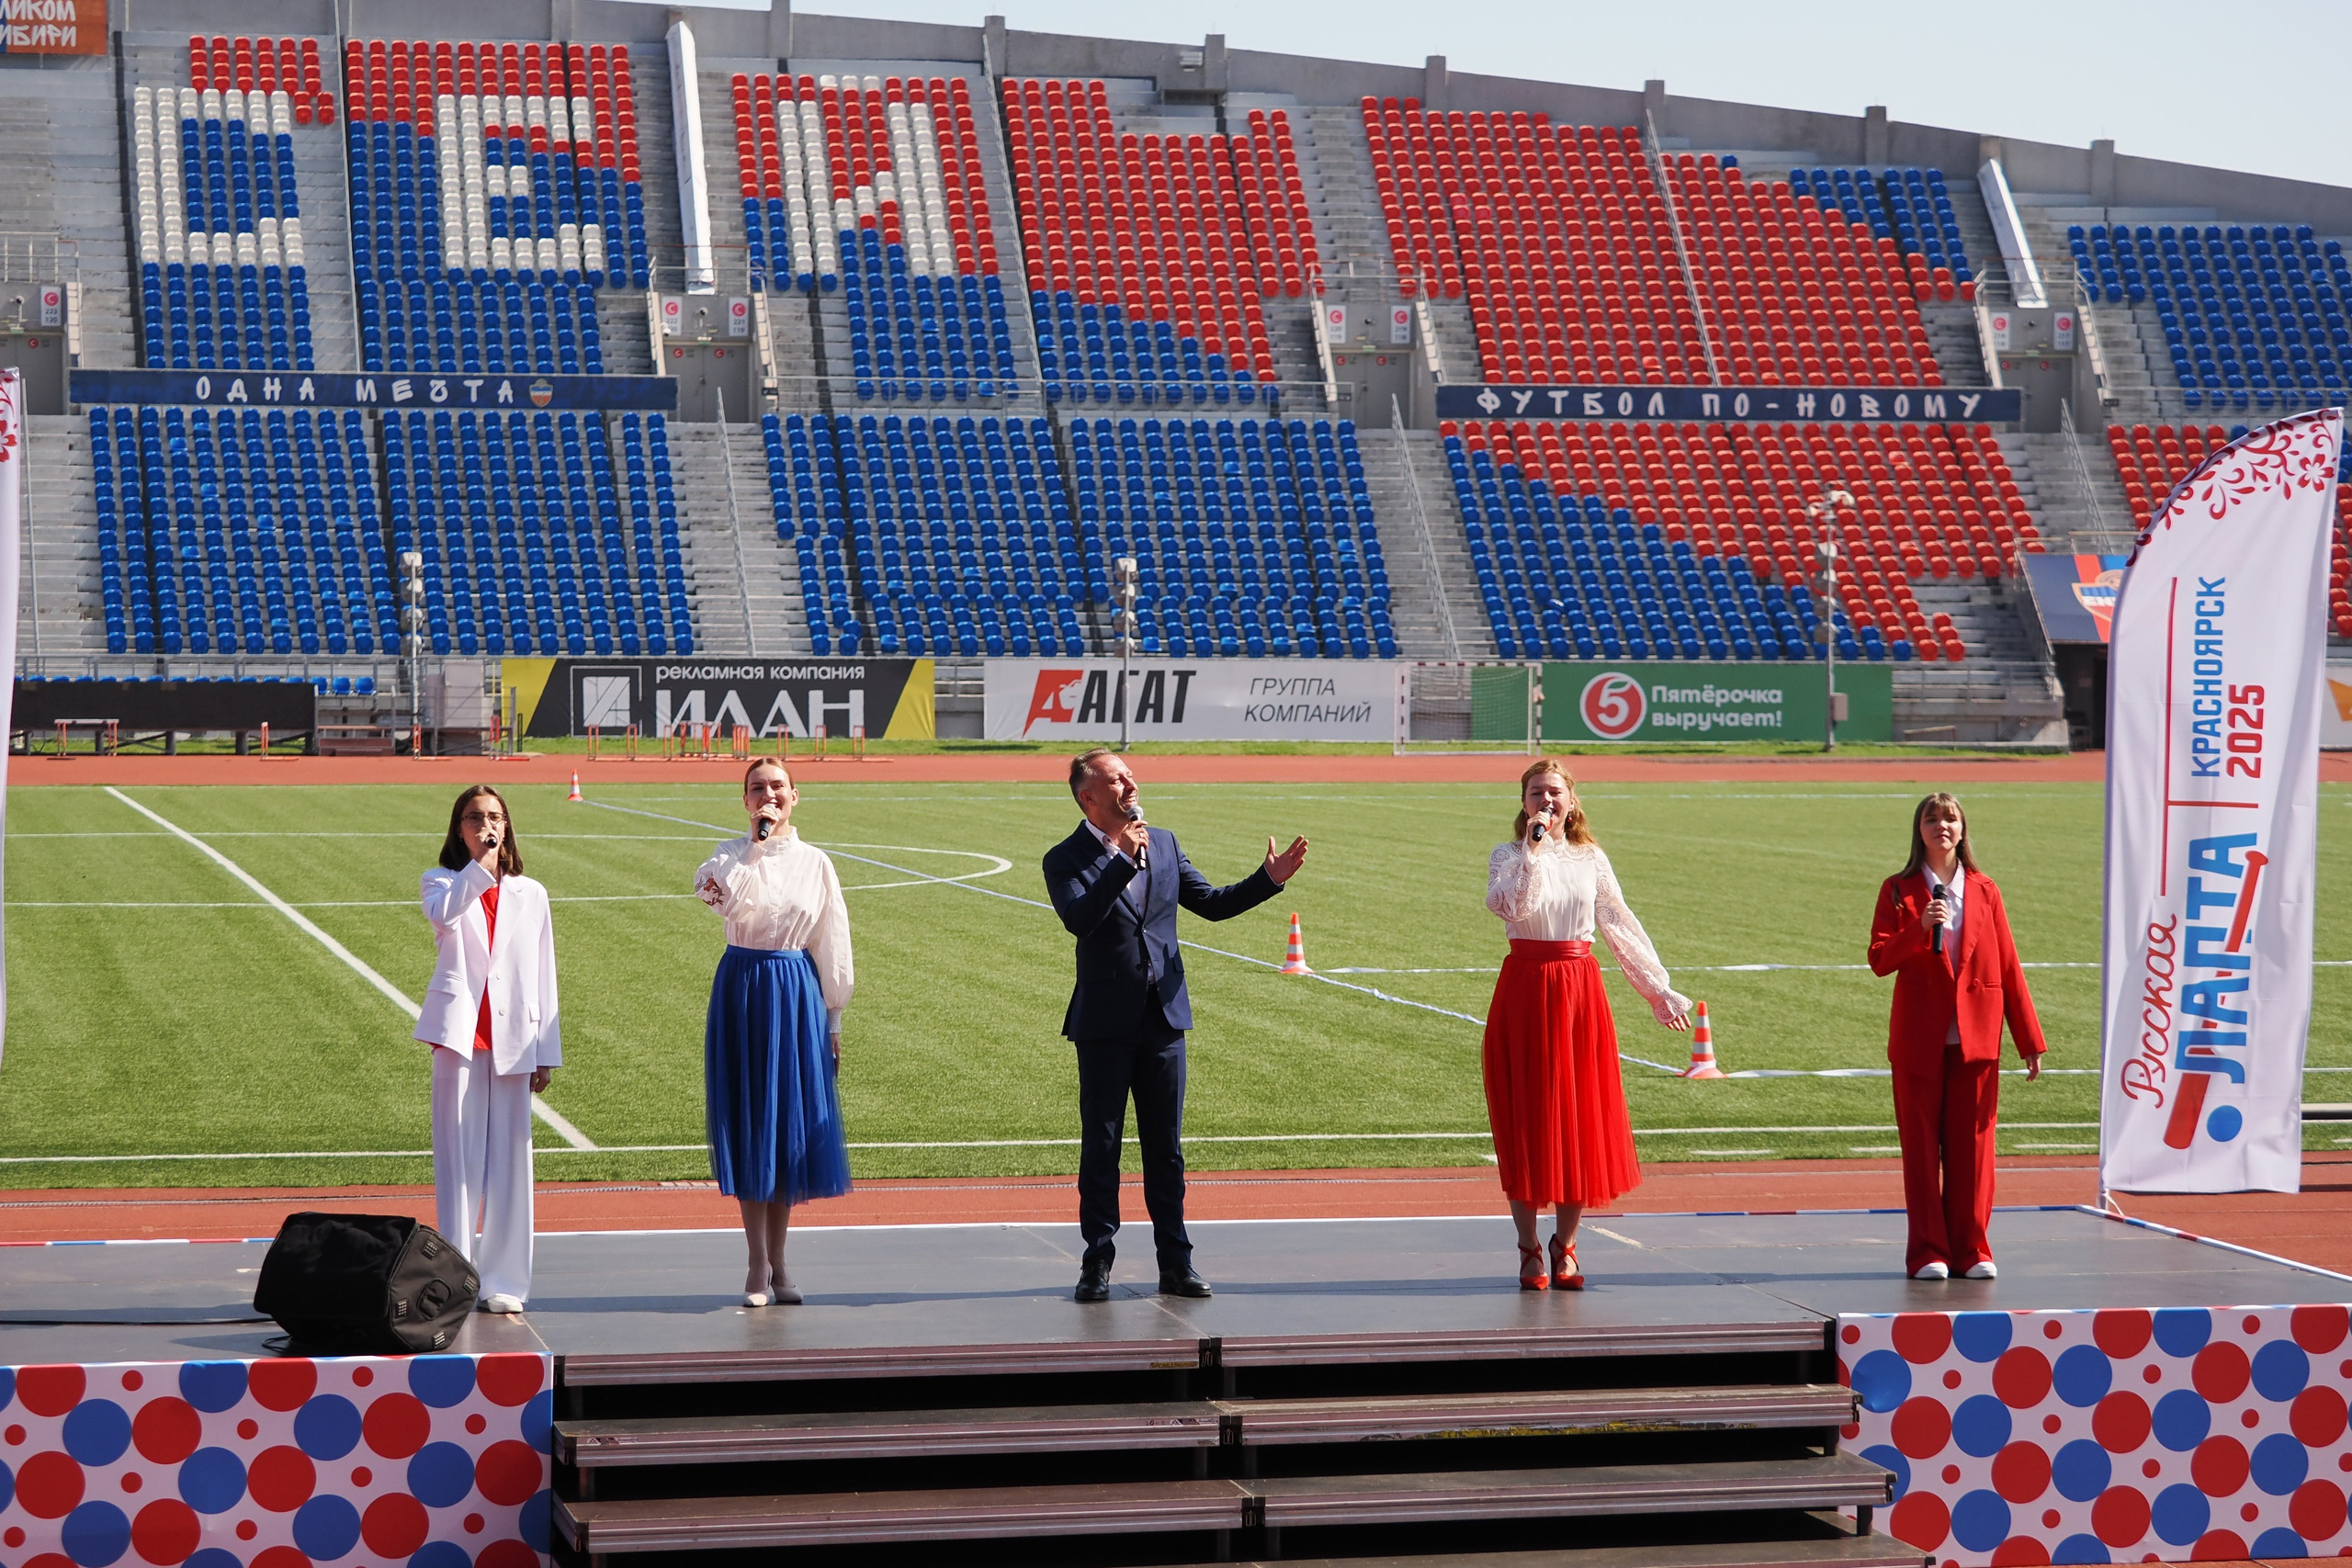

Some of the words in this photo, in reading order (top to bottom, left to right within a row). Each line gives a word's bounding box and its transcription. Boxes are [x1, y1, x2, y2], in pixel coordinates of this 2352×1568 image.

[195, 375, 316, 402] ОДНА
[1476, 387, 1666, 417] ФУТБОЛ
[1702, 392, 1981, 418] ПО-НОВОМУ
[655, 665, 764, 683] рекламная
[770, 665, 865, 680] компания
[1250, 678, 1336, 695] ГРУППА
[2190, 576, 2226, 778] КРАСНОЯРСК
[655, 689, 865, 739] ИЛАН
[1077, 670, 1197, 724] АГАТ
[1244, 701, 1372, 723] КОМПАНИЙ
[1596, 678, 1634, 728] 5
[1651, 683, 1783, 707] Пятёрочка
[1651, 710, 1782, 731] выручает!
[2225, 684, 2266, 780] 2025
[2174, 831, 2259, 1085] ЛАПТА
[2120, 912, 2177, 1110] Русская
